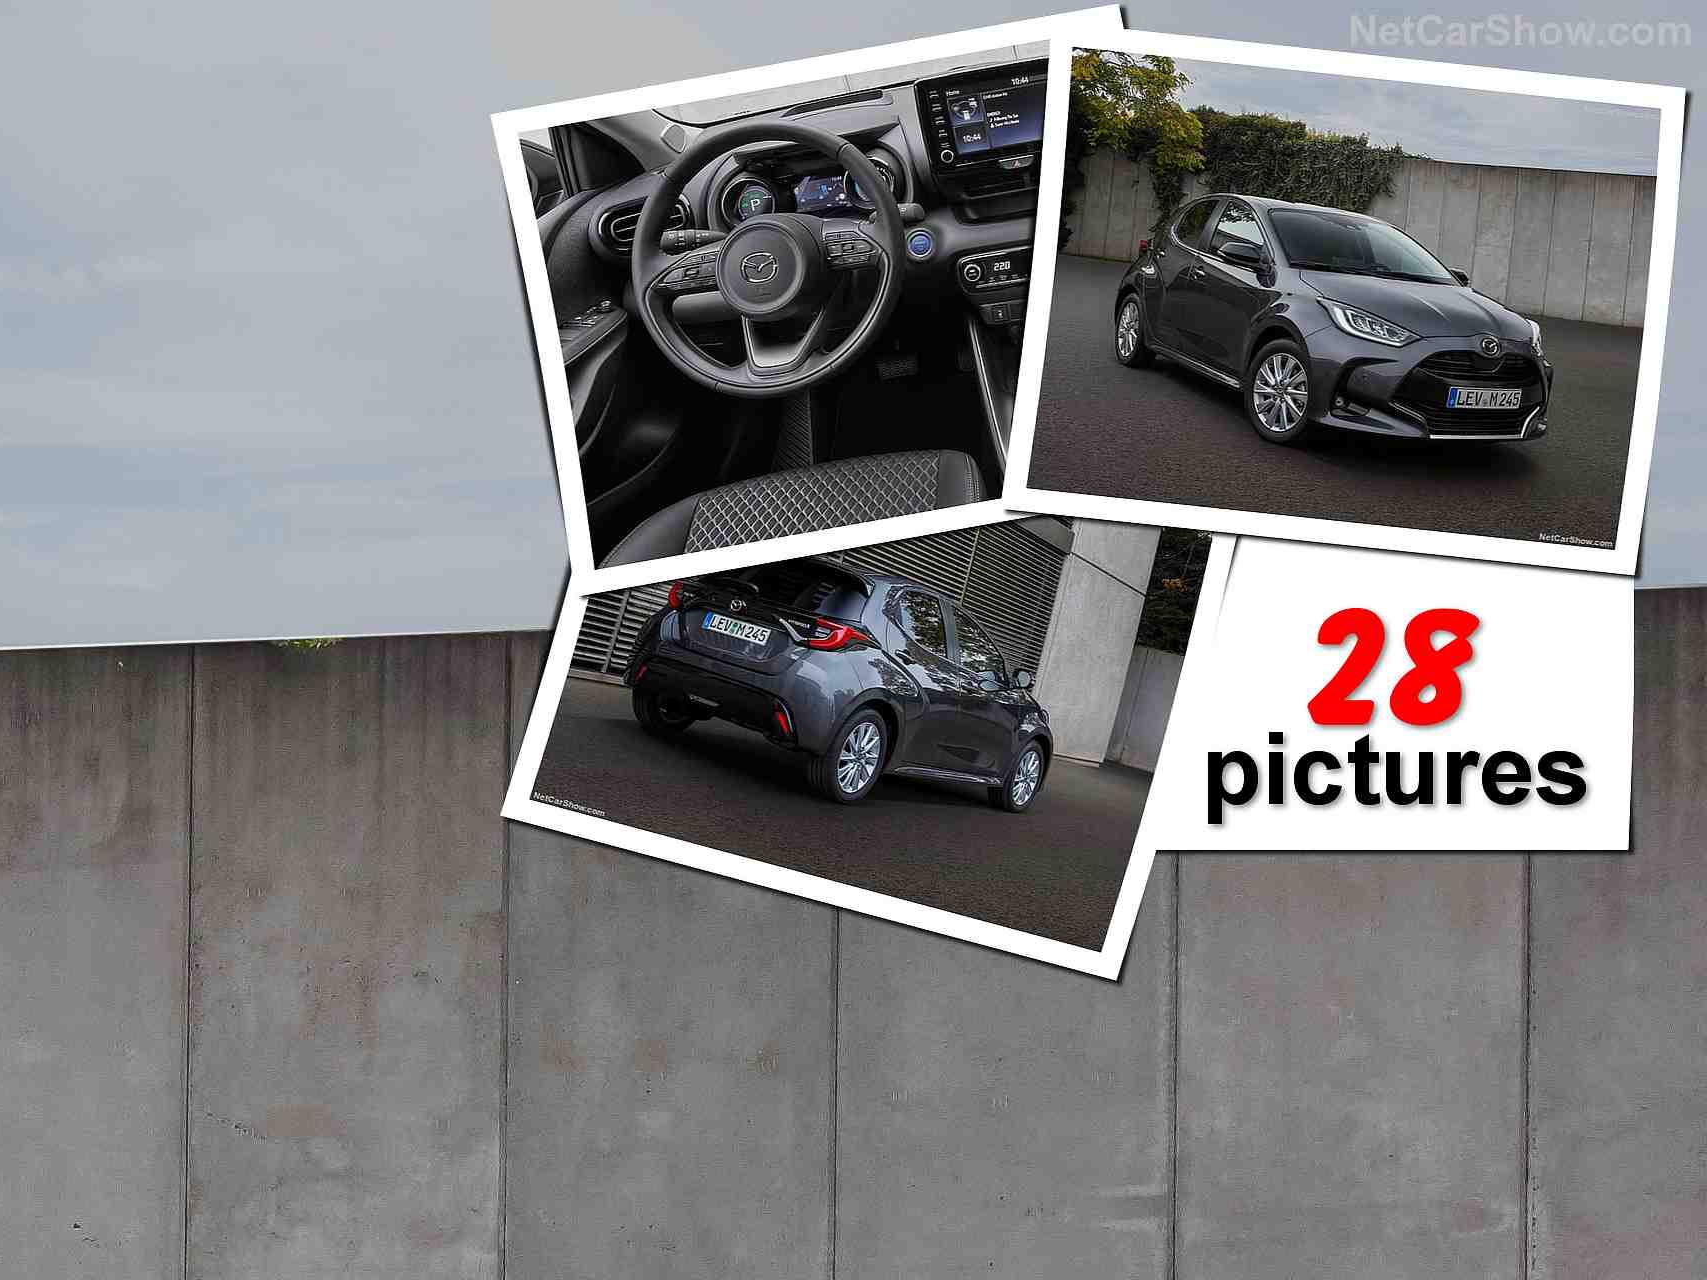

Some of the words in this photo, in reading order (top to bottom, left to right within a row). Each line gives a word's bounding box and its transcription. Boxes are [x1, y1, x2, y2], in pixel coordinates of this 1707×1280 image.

[1457, 391, 1483, 406] LEV
[1489, 391, 1499, 407] M
[1498, 391, 1521, 407] 245
[710, 614, 733, 632] LEV
[745, 625, 769, 643] 245
